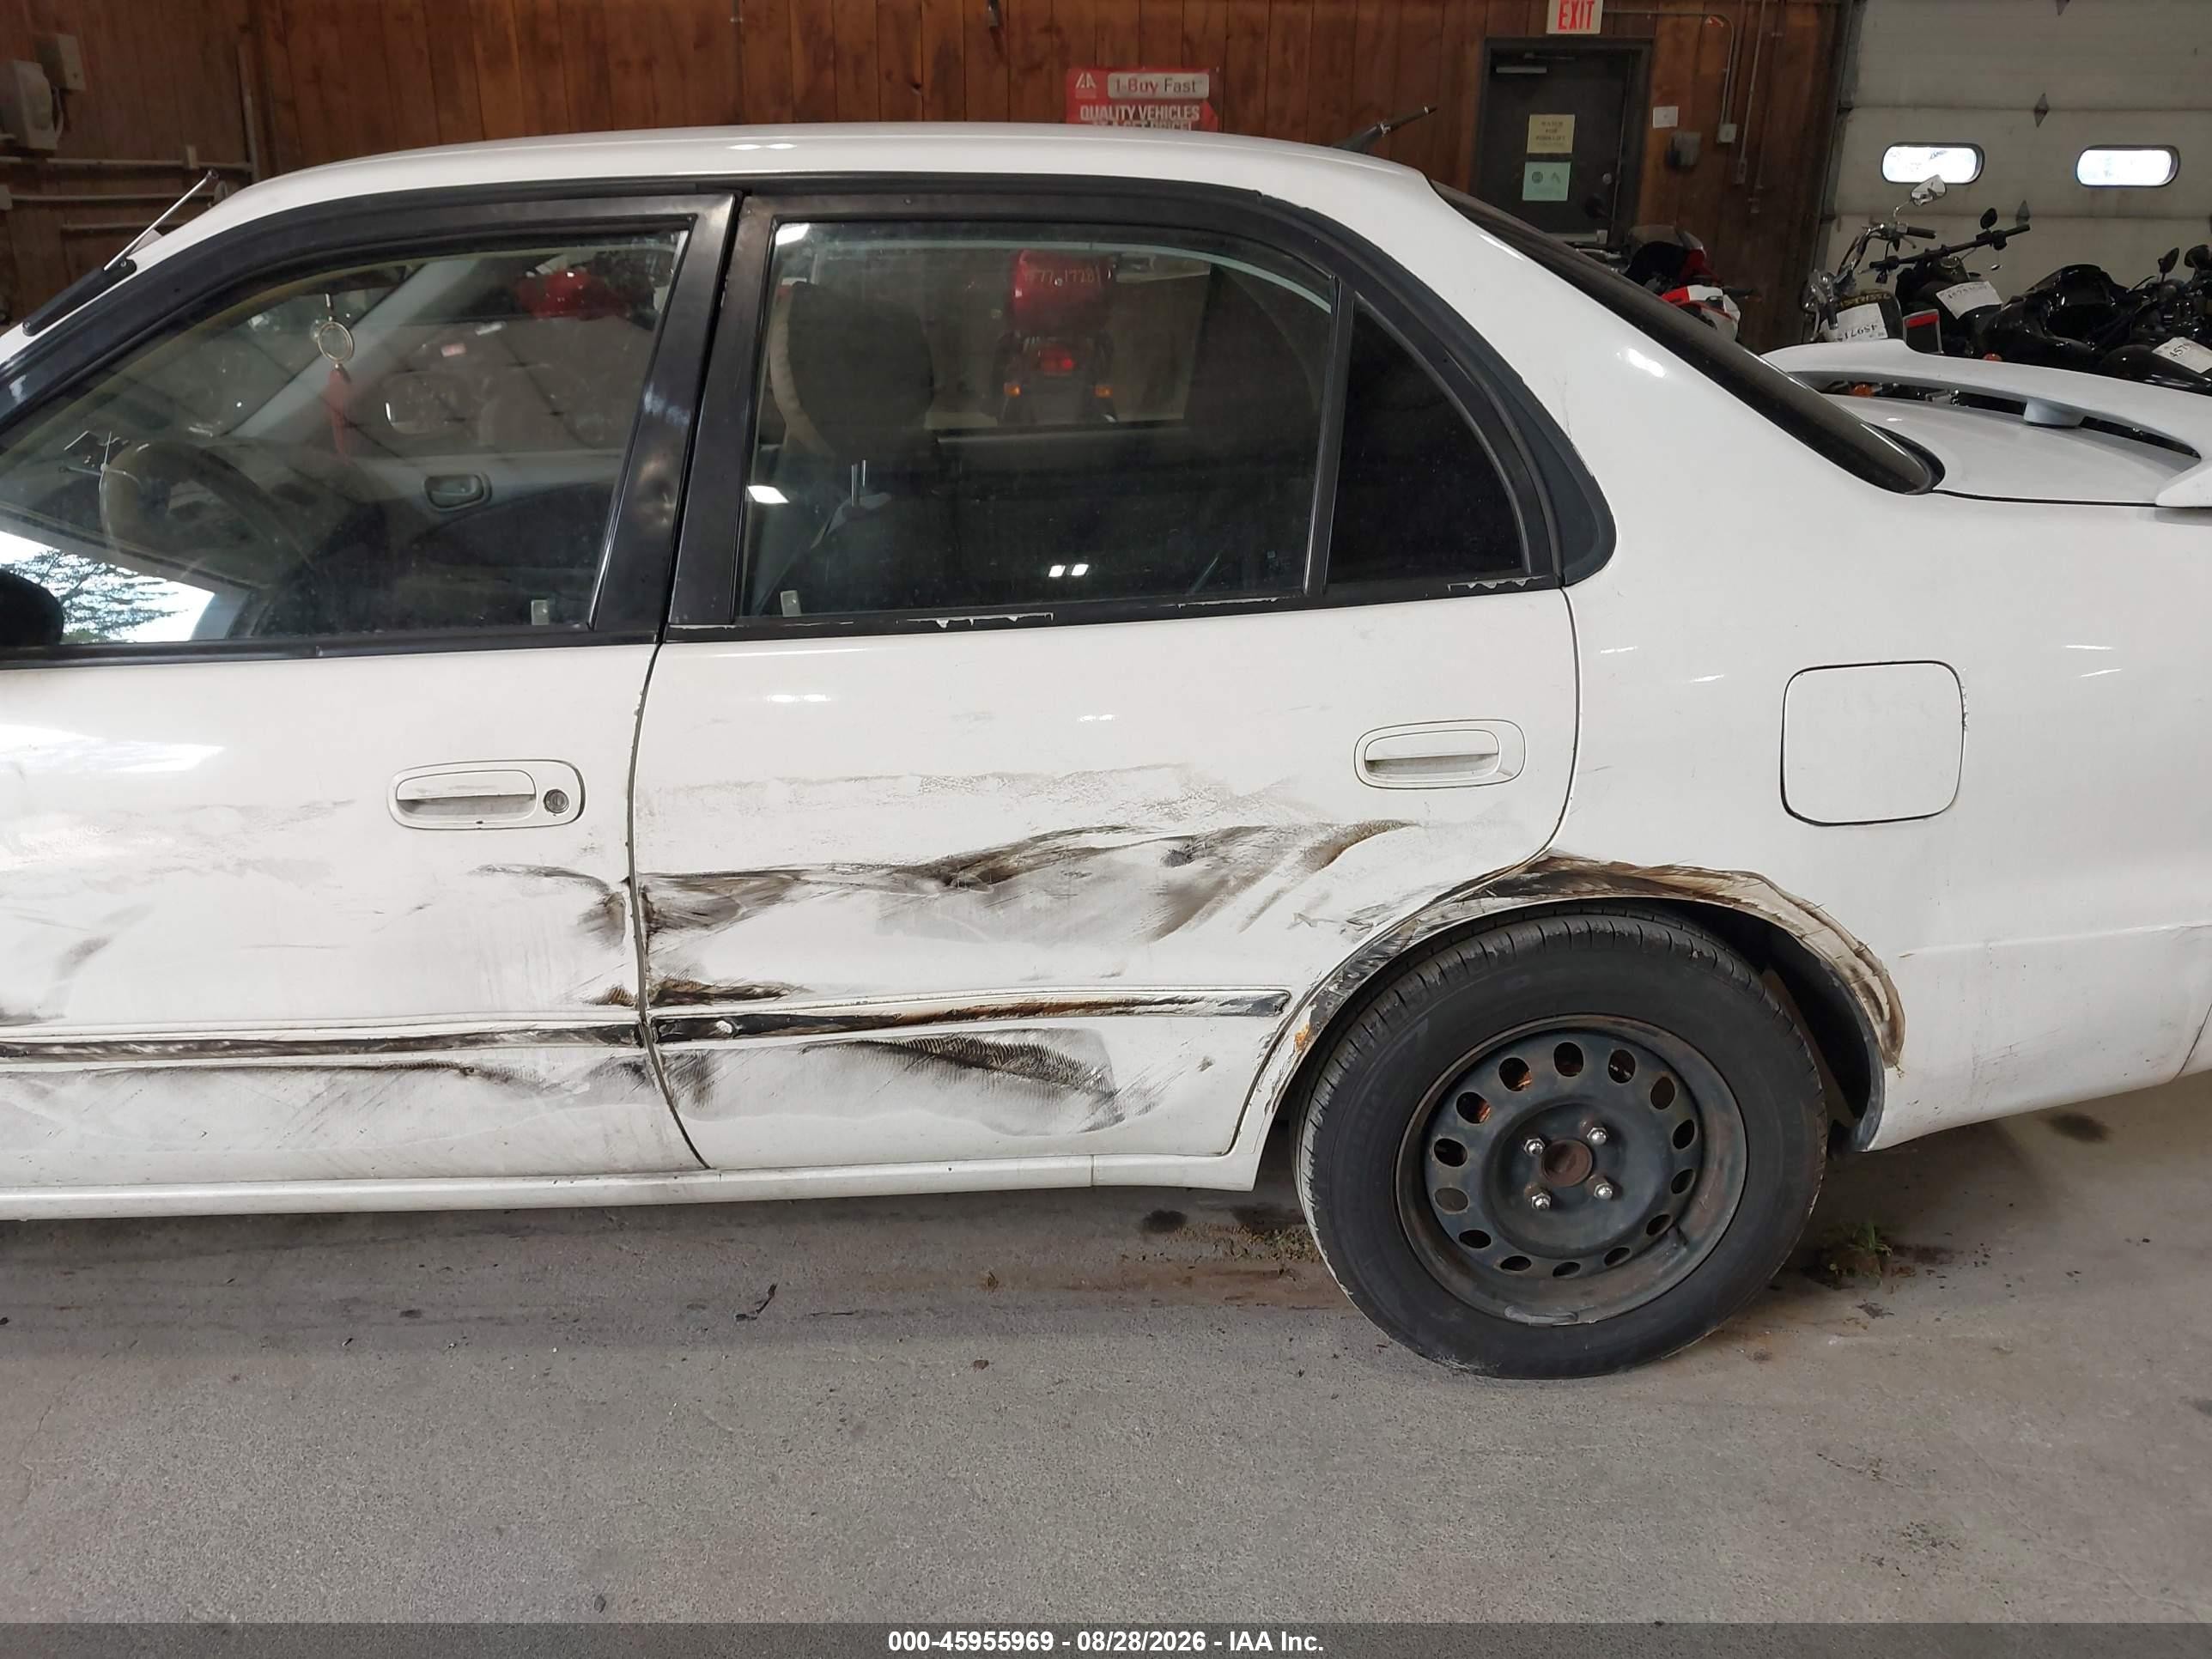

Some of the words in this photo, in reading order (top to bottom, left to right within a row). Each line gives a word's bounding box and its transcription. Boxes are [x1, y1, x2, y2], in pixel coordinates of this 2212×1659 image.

[1558, 0, 1595, 30] EXIT
[1164, 77, 1196, 94] Fast
[1079, 105, 1136, 121] QUALITY
[1138, 105, 1200, 121] VEHICLES
